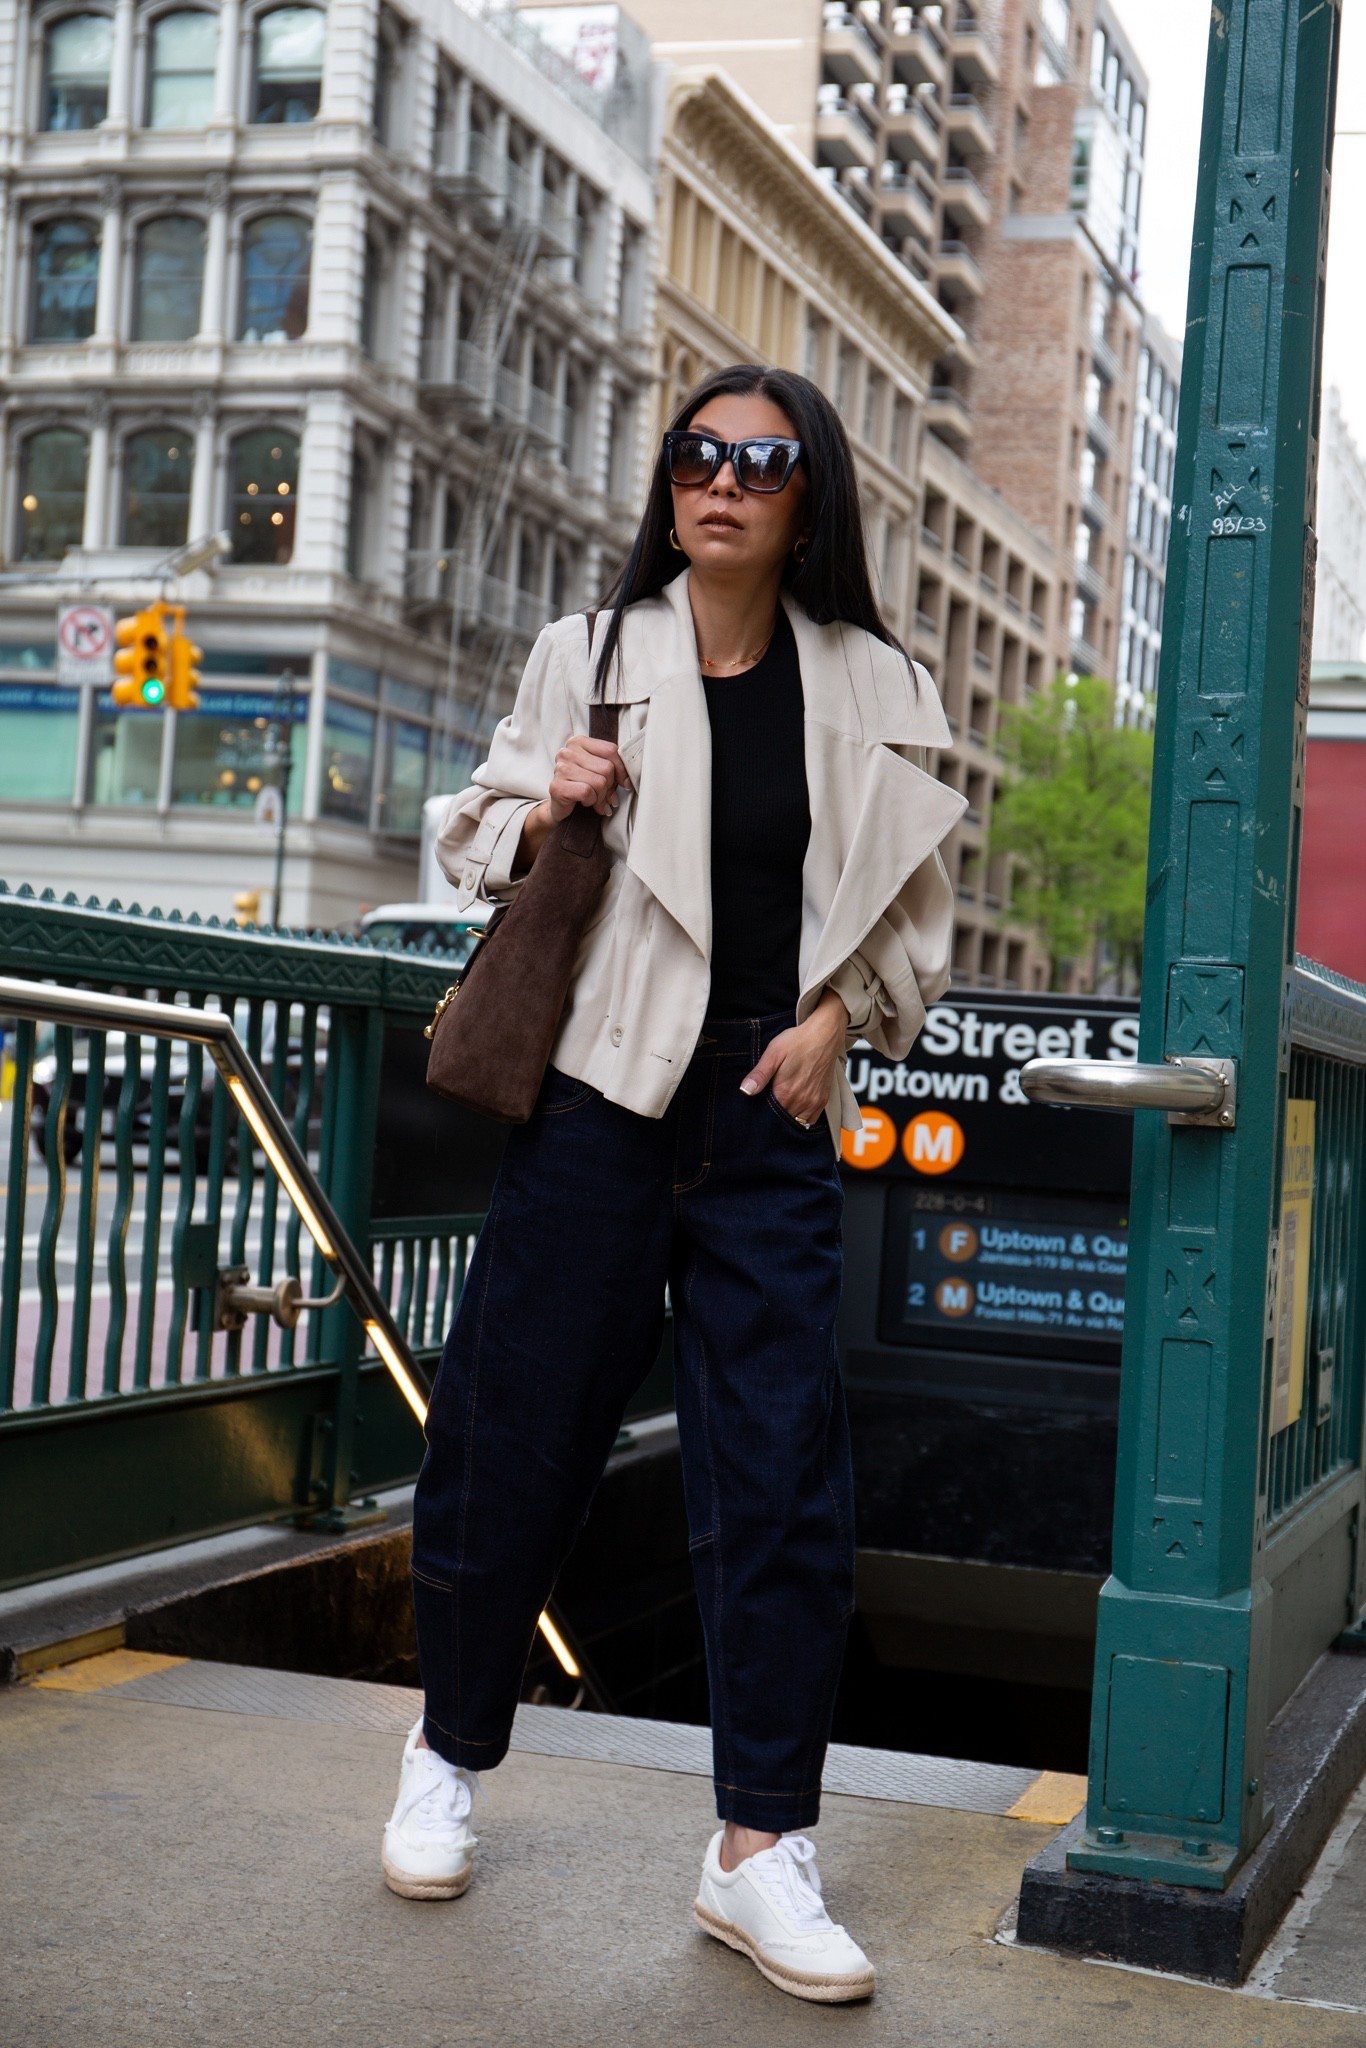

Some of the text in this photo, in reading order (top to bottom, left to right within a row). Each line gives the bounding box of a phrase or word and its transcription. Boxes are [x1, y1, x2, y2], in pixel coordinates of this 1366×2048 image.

[921, 1007, 1092, 1060] Street
[846, 1057, 1031, 1105] Uptown &
[853, 1119, 954, 1163] F M
[913, 1225, 1129, 1257] 1 F Uptown & Qu
[908, 1281, 1125, 1313] 2 M Uptown & Qu
